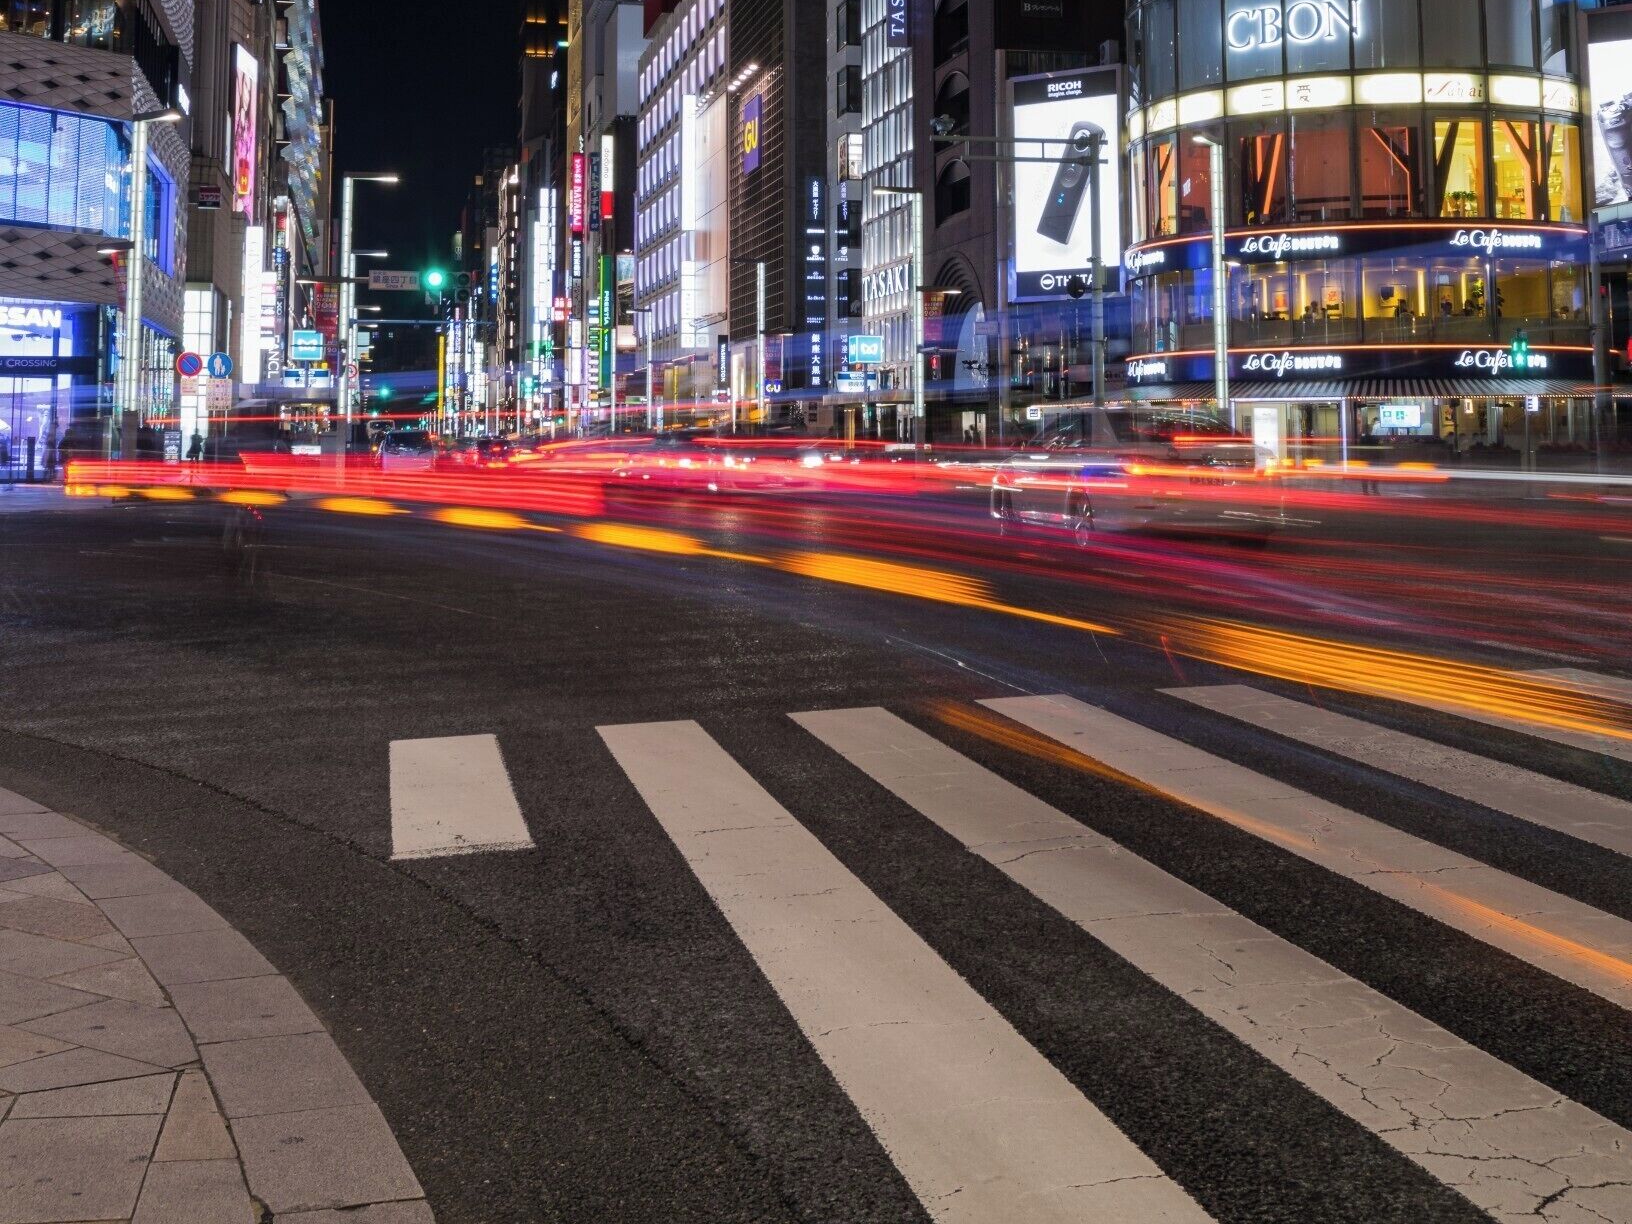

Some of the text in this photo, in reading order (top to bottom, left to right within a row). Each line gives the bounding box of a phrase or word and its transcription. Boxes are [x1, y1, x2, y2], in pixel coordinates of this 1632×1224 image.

[1047, 80, 1082, 93] RICOH
[743, 114, 759, 154] GU
[1240, 236, 1258, 253] Le
[1259, 233, 1292, 258] Café
[1450, 229, 1469, 247] Le
[1469, 229, 1502, 255] Café
[862, 262, 909, 302] TASAKI
[1055, 274, 1094, 288] THTA
[6, 359, 57, 368] CROSSING
[1242, 353, 1261, 370] Le
[1261, 352, 1294, 377] Café
[1454, 350, 1474, 368] Le
[1475, 350, 1508, 375] Café
[765, 383, 781, 393] GU
